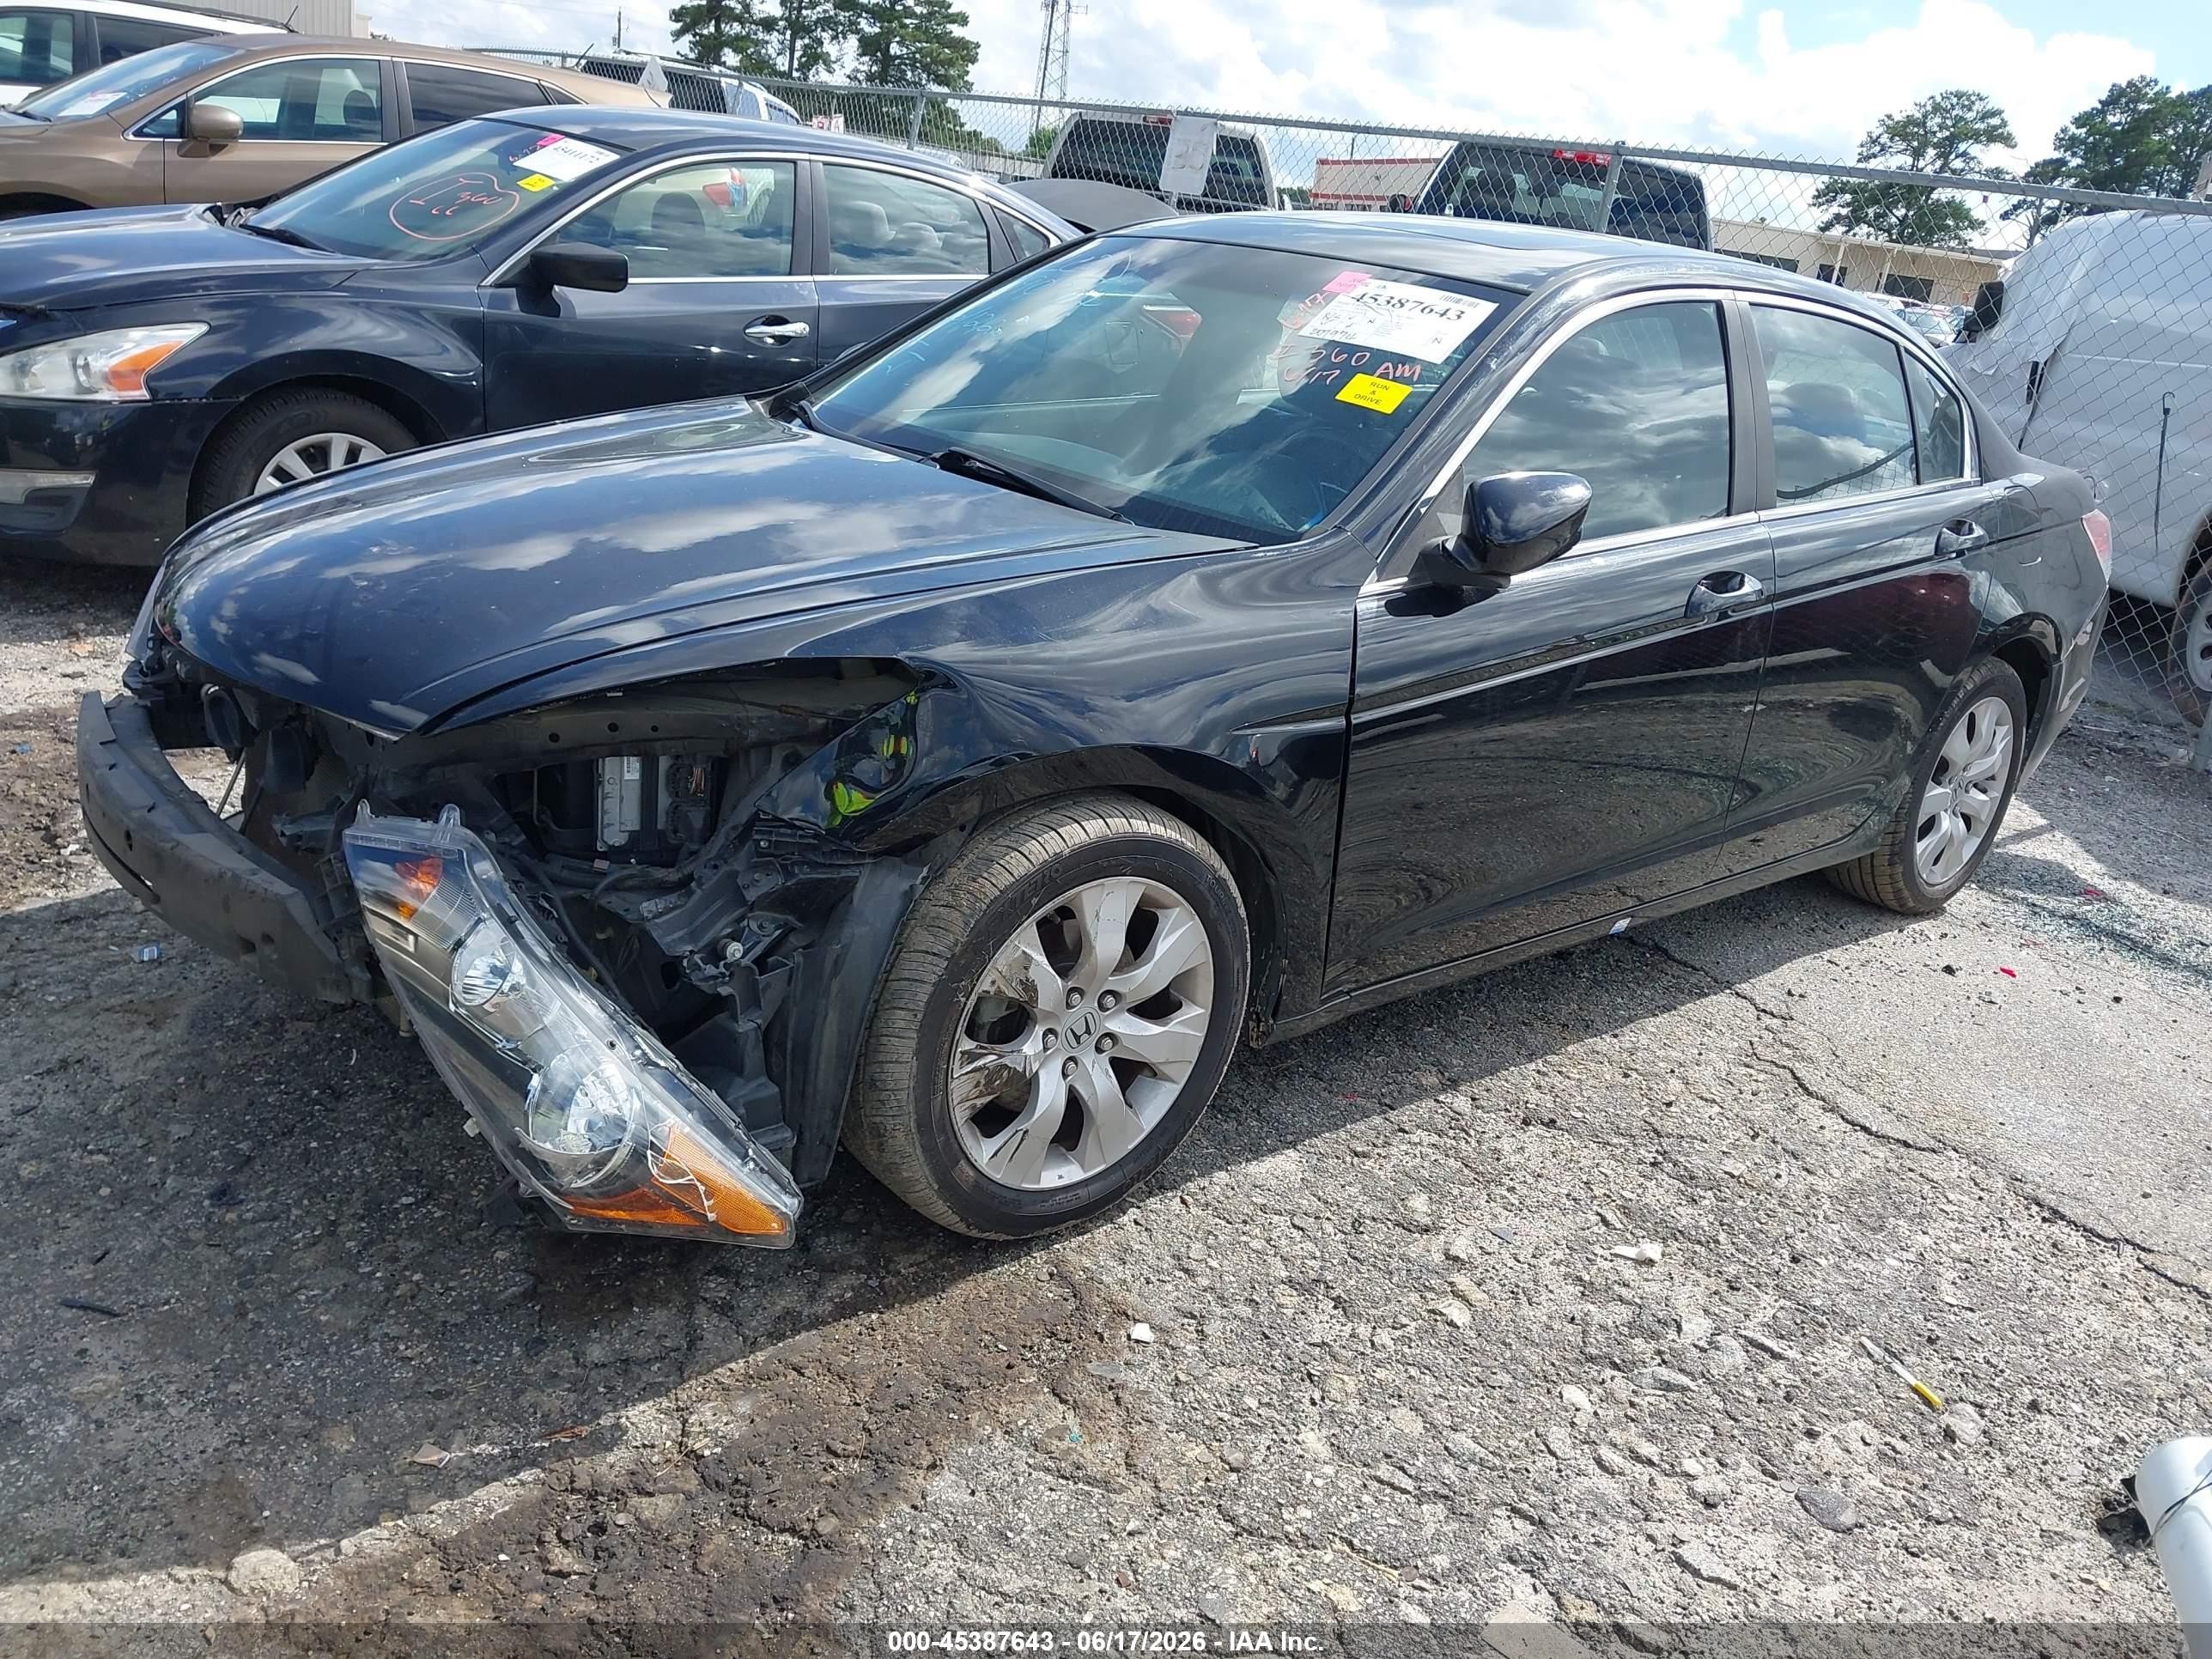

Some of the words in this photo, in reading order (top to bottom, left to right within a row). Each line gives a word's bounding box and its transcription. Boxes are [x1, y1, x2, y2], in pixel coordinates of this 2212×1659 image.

[1351, 291, 1466, 321] 45387643
[1305, 346, 1371, 367] 360
[1373, 362, 1422, 383] AM
[1369, 380, 1391, 392] RUN
[1353, 392, 1382, 406] DRIVE
